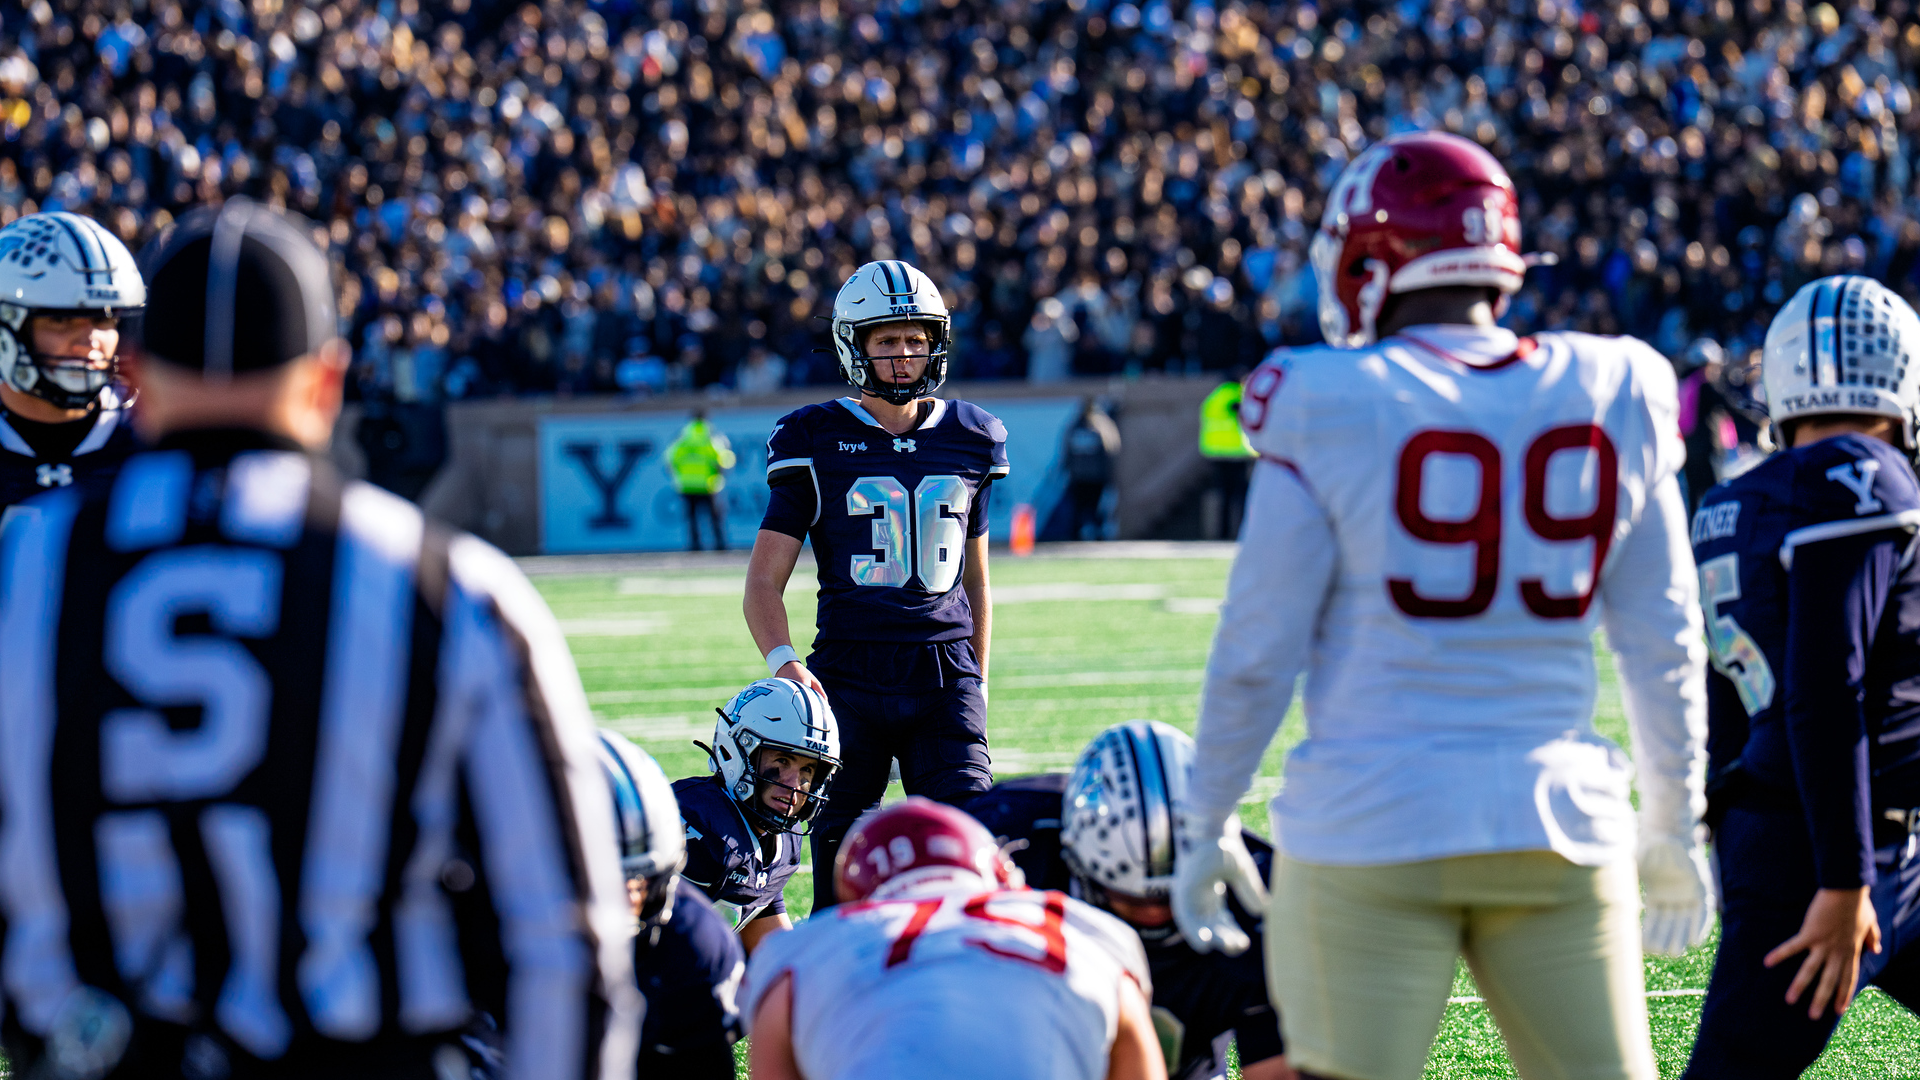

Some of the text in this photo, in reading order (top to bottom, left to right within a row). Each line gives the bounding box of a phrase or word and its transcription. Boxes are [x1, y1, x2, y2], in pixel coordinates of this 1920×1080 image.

[889, 305, 918, 314] YALE
[1782, 392, 1840, 412] TEAM
[838, 441, 858, 453] Ivy
[563, 439, 654, 530] Y
[1825, 459, 1882, 515] Y
[846, 475, 969, 593] 36
[1386, 424, 1618, 619] 99
[100, 545, 284, 804] S
[728, 687, 773, 723] Y
[805, 740, 830, 753] YALE
[729, 870, 745, 884] Ivy
[838, 890, 1069, 974] 79
